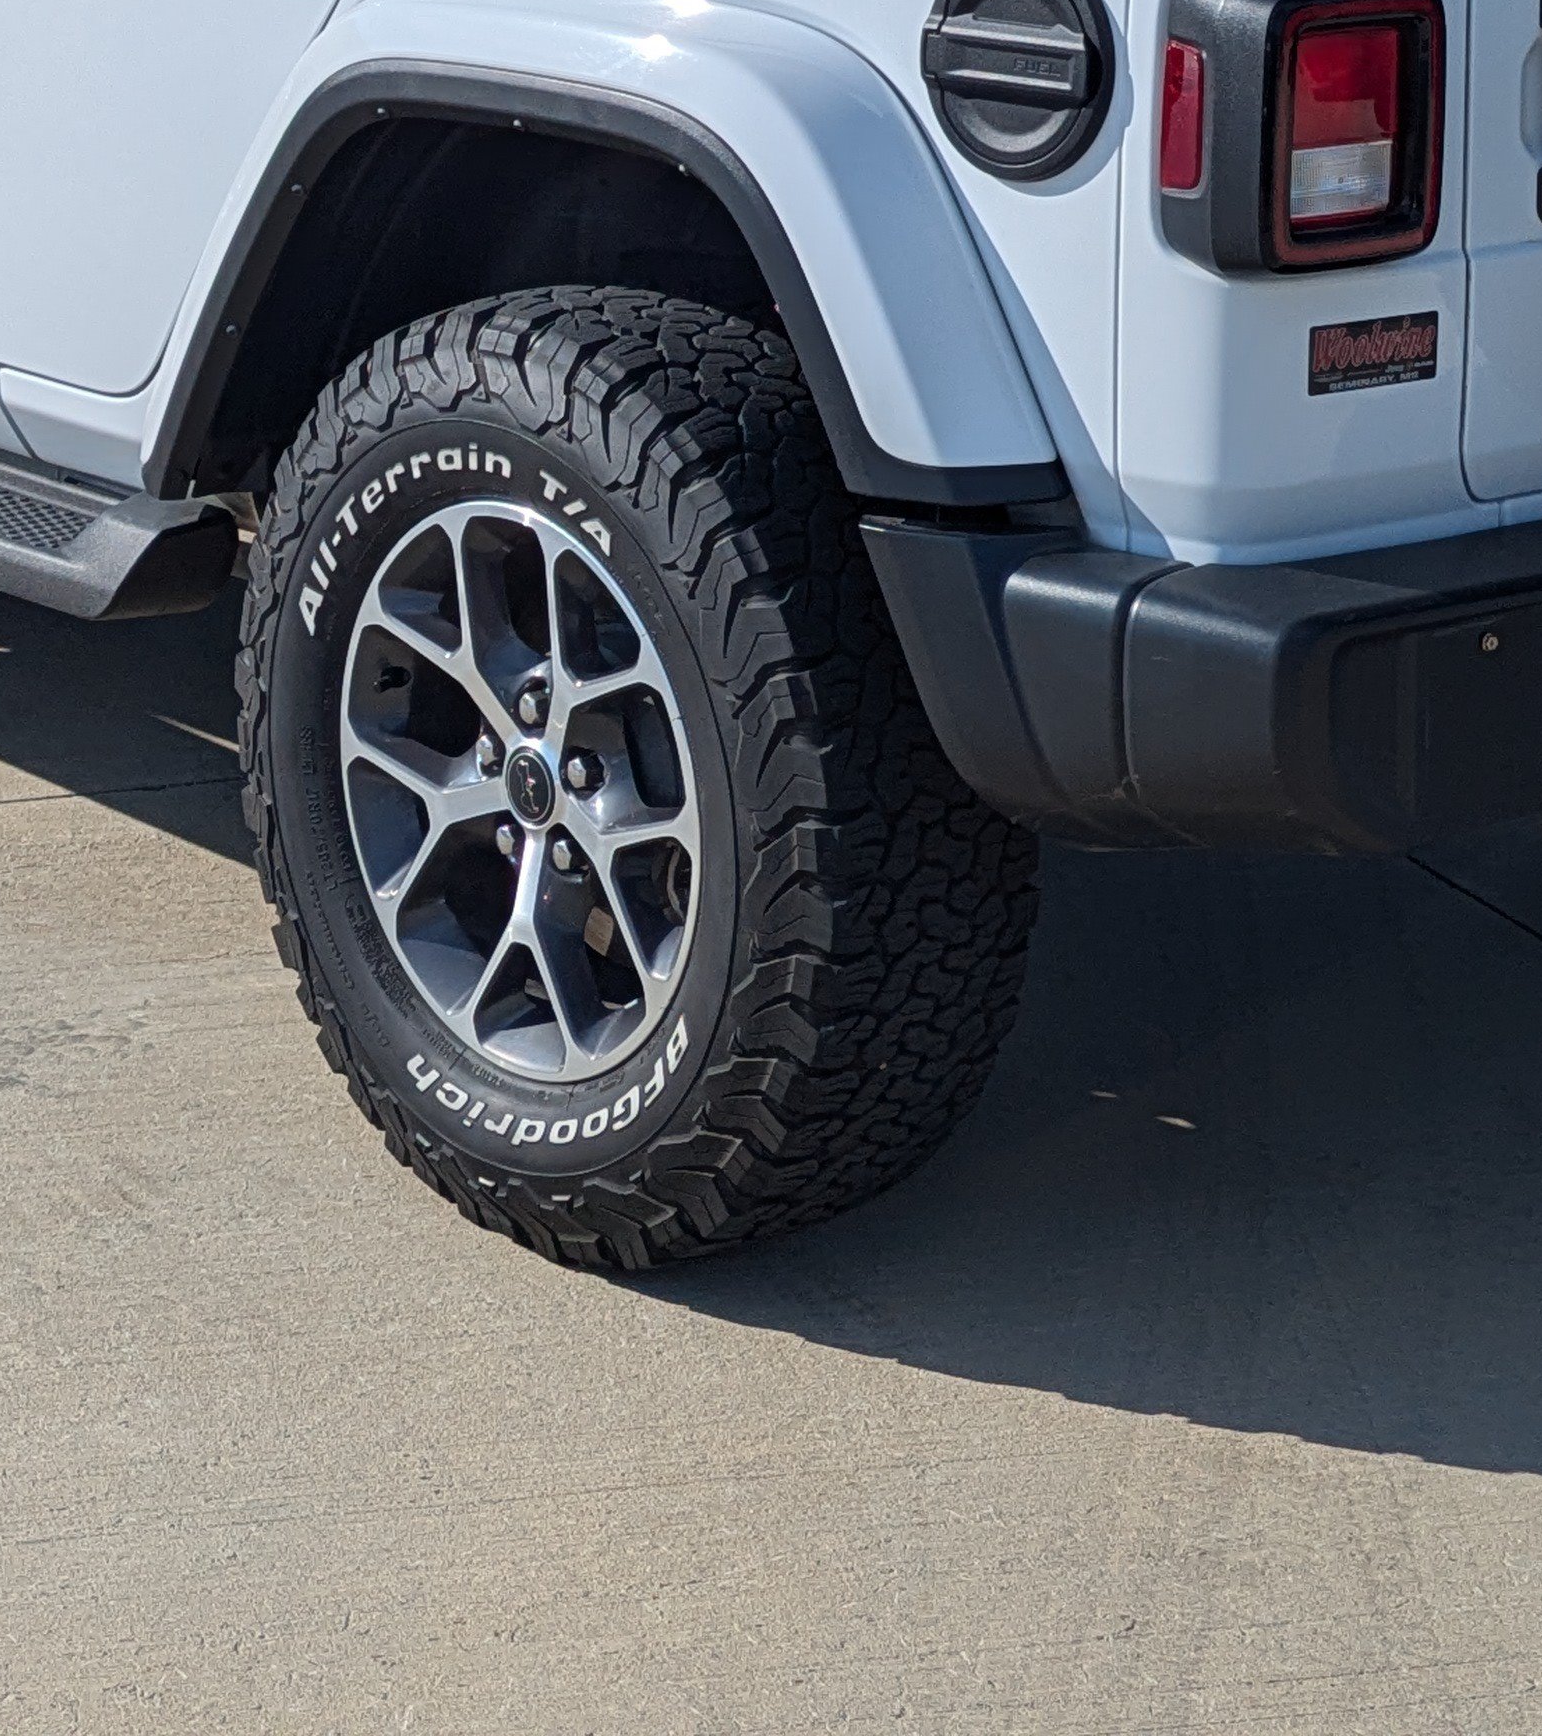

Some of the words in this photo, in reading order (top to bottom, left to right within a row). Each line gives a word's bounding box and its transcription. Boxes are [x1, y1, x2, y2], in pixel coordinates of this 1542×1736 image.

[1013, 57, 1061, 78] FUEL
[298, 442, 511, 637] All-Terrain
[539, 469, 612, 557] T/A
[406, 1013, 689, 1146] BFGoodrich
